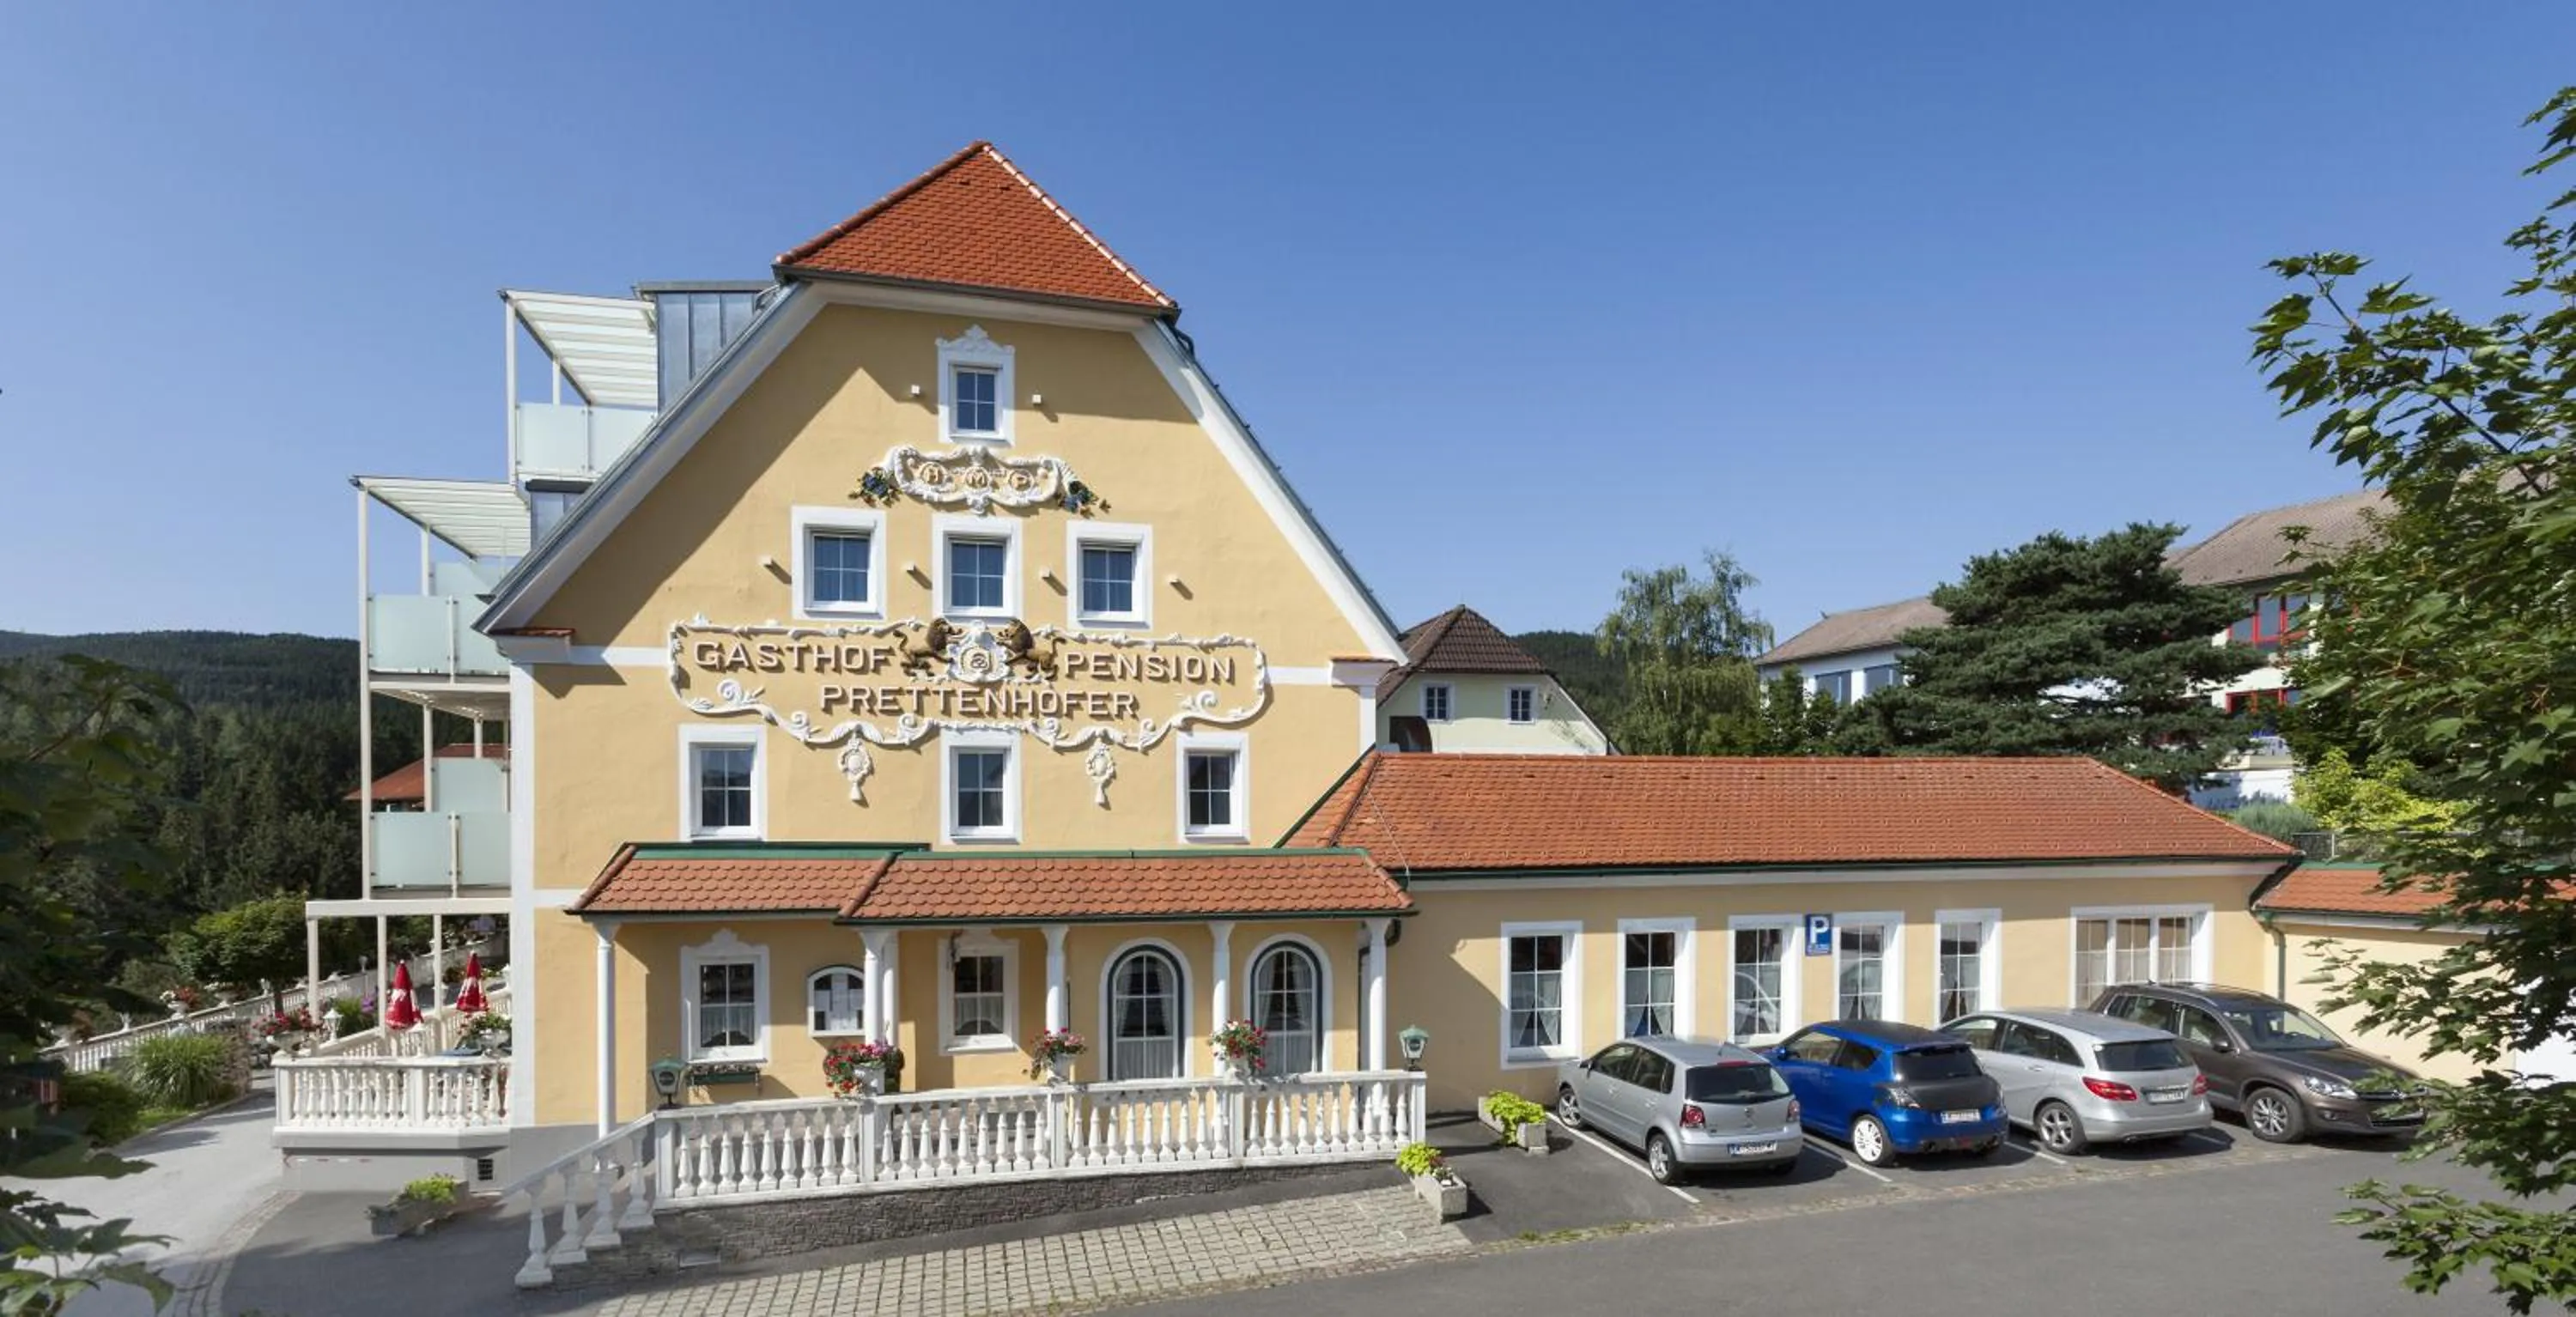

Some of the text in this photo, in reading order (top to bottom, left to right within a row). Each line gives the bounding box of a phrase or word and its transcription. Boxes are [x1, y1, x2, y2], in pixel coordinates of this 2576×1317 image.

[692, 640, 894, 673] GASTHOF
[1064, 652, 1234, 682] PENSION
[820, 684, 1137, 718] PRETTENHOFER
[1810, 916, 1829, 943] P
